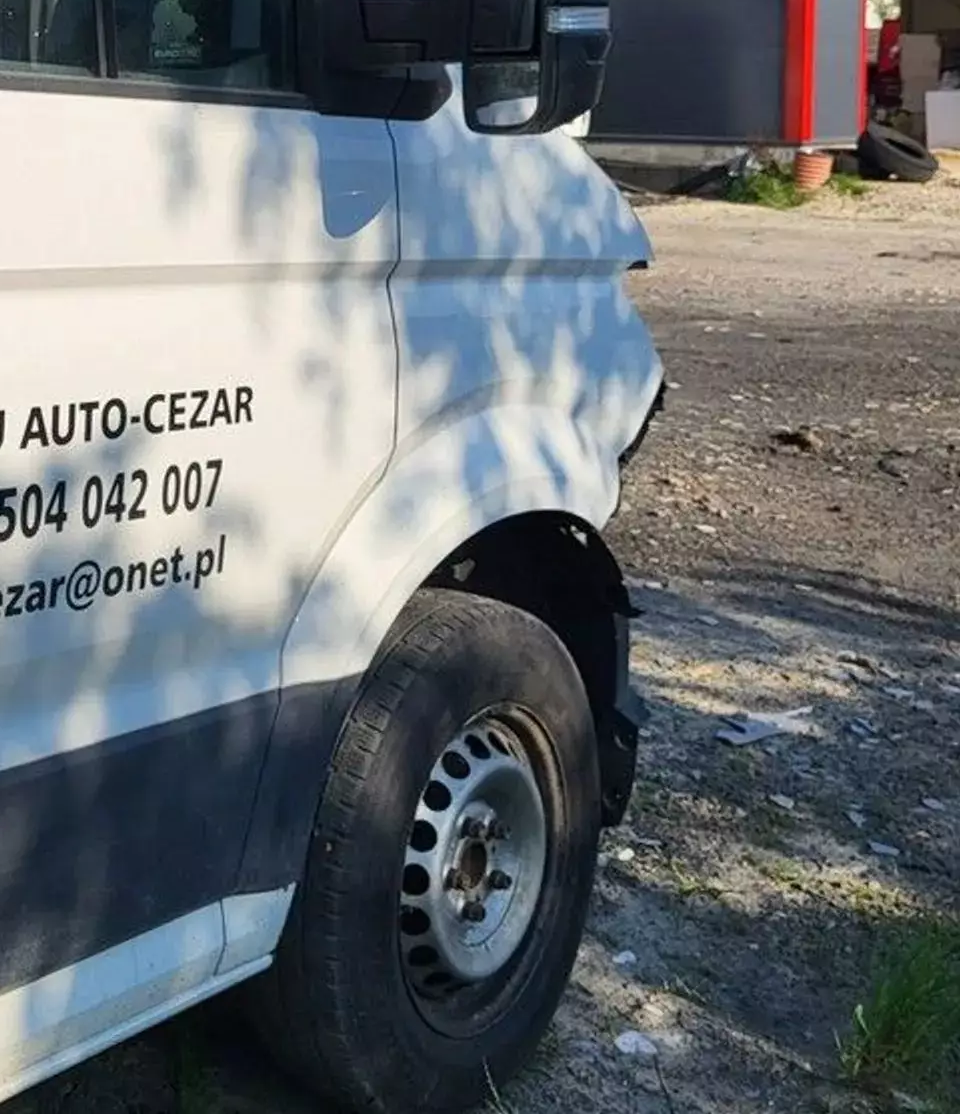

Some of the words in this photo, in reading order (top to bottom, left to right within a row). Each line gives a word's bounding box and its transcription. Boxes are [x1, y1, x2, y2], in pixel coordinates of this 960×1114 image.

[19, 386, 253, 449] AUTO-CEZAR
[82, 469, 148, 528] 042
[161, 459, 222, 515] 007
